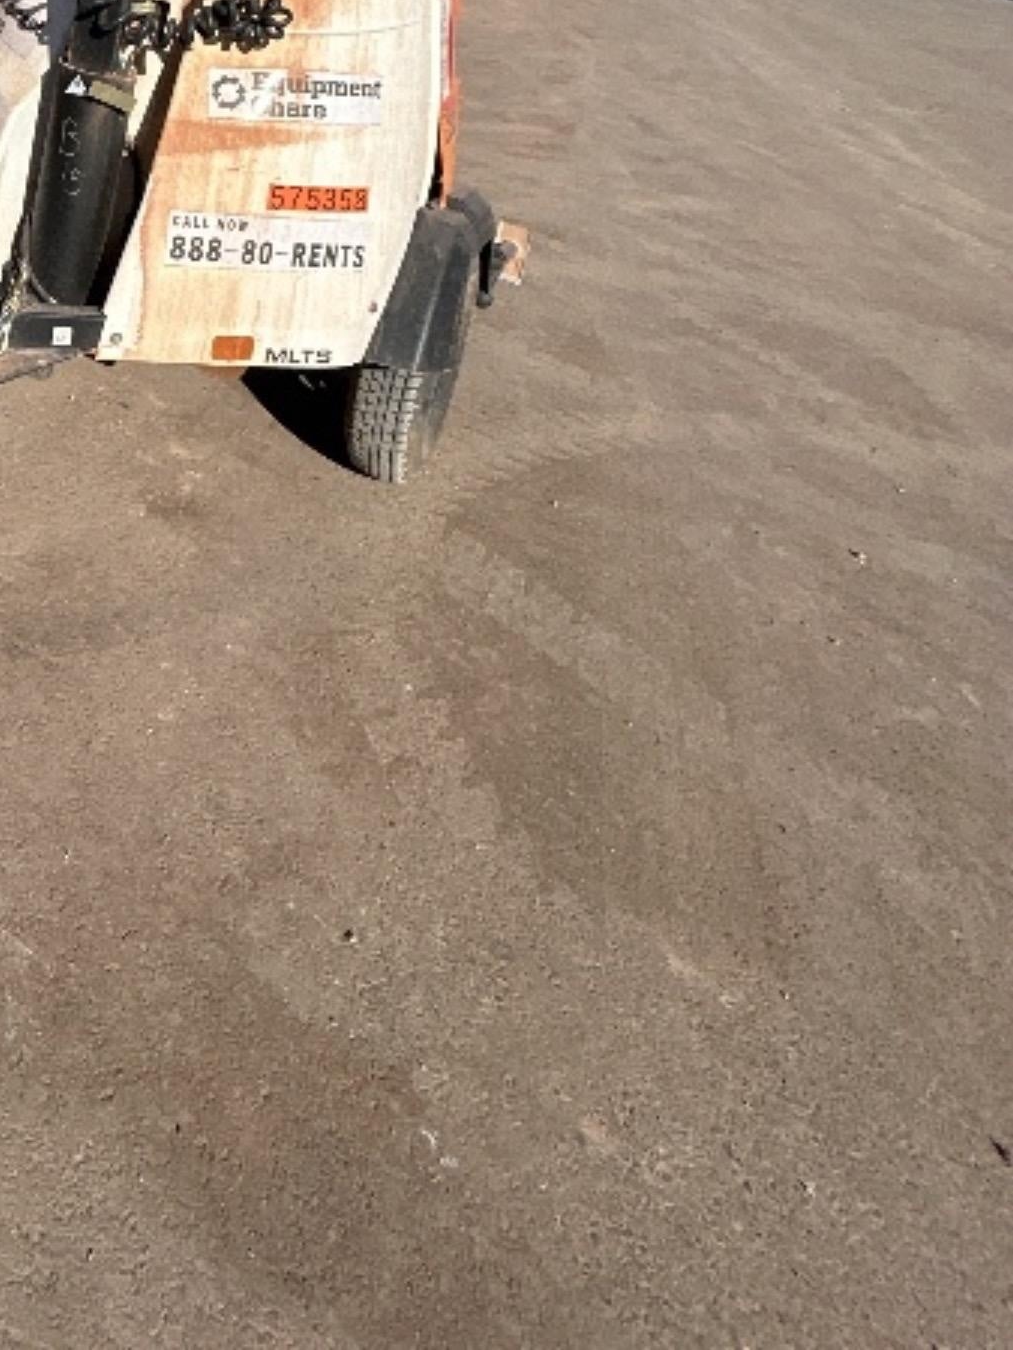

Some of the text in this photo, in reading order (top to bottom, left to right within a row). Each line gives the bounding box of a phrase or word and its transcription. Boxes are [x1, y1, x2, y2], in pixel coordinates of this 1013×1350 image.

[251, 96, 327, 119] hare
[172, 215, 210, 229] CALL
[170, 235, 366, 268] 888-80-RENTS
